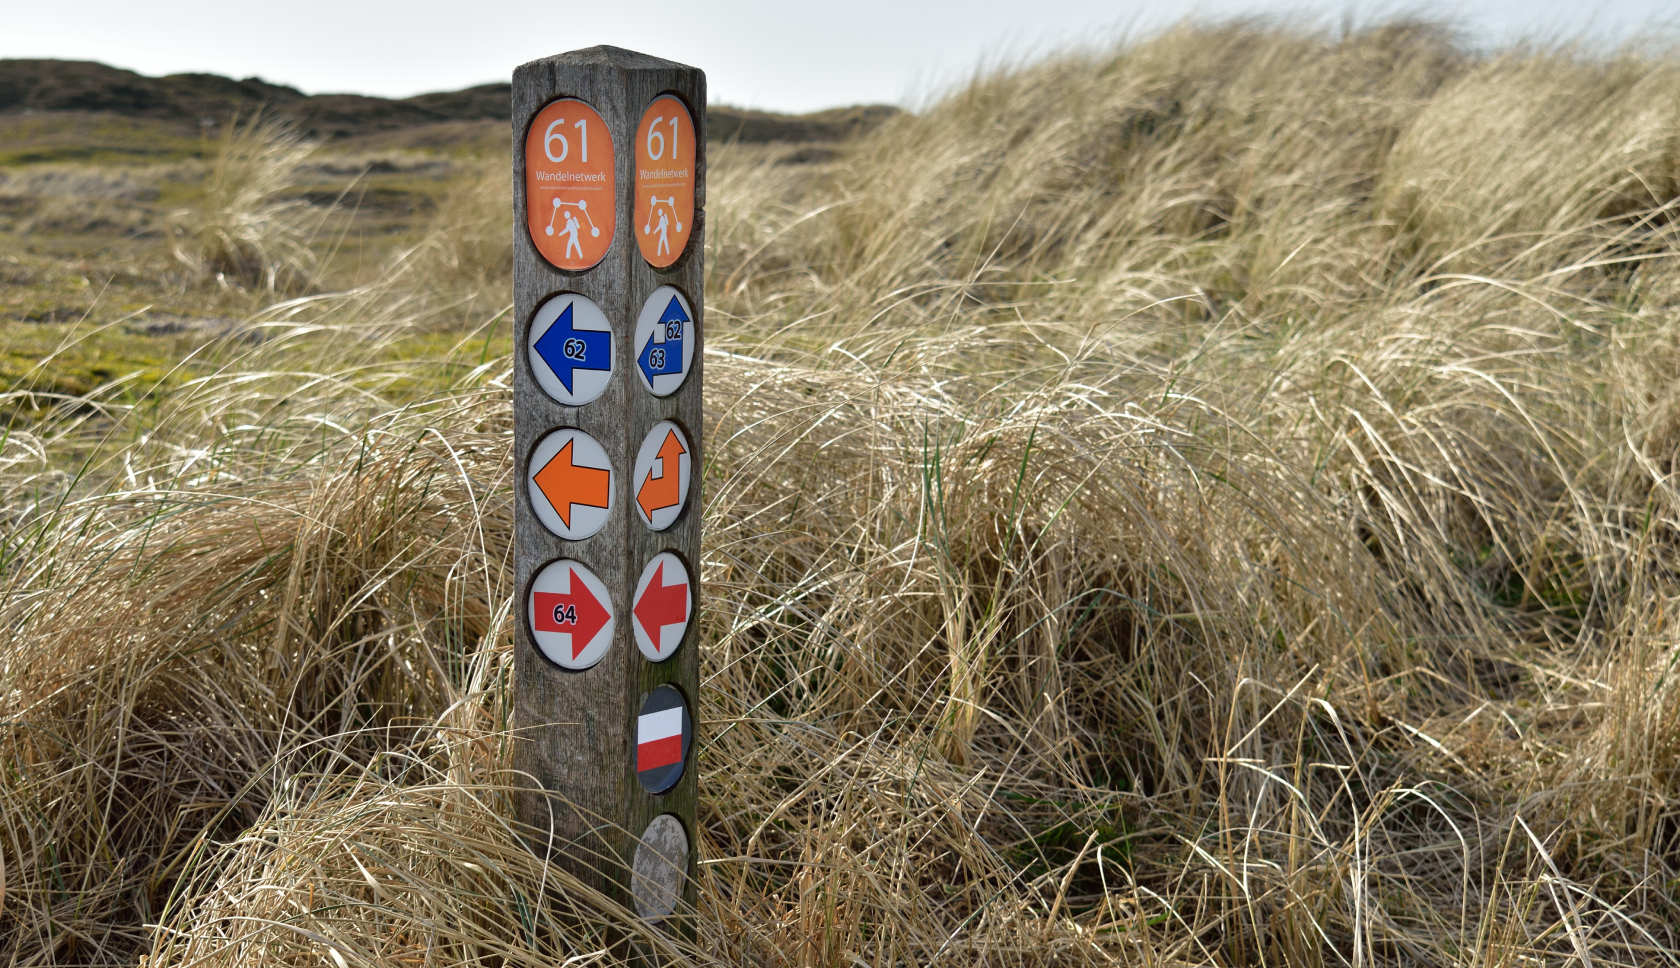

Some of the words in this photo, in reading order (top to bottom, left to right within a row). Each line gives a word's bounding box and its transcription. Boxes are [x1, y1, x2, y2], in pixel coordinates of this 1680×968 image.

[544, 118, 588, 163] 61
[647, 116, 679, 161] 61
[536, 171, 606, 182] Wandelnetwerk
[640, 167, 689, 180] Wandelnetwerk
[666, 319, 682, 340] 62
[564, 339, 586, 360] 62
[649, 348, 665, 370] 63
[553, 604, 577, 625] 64
